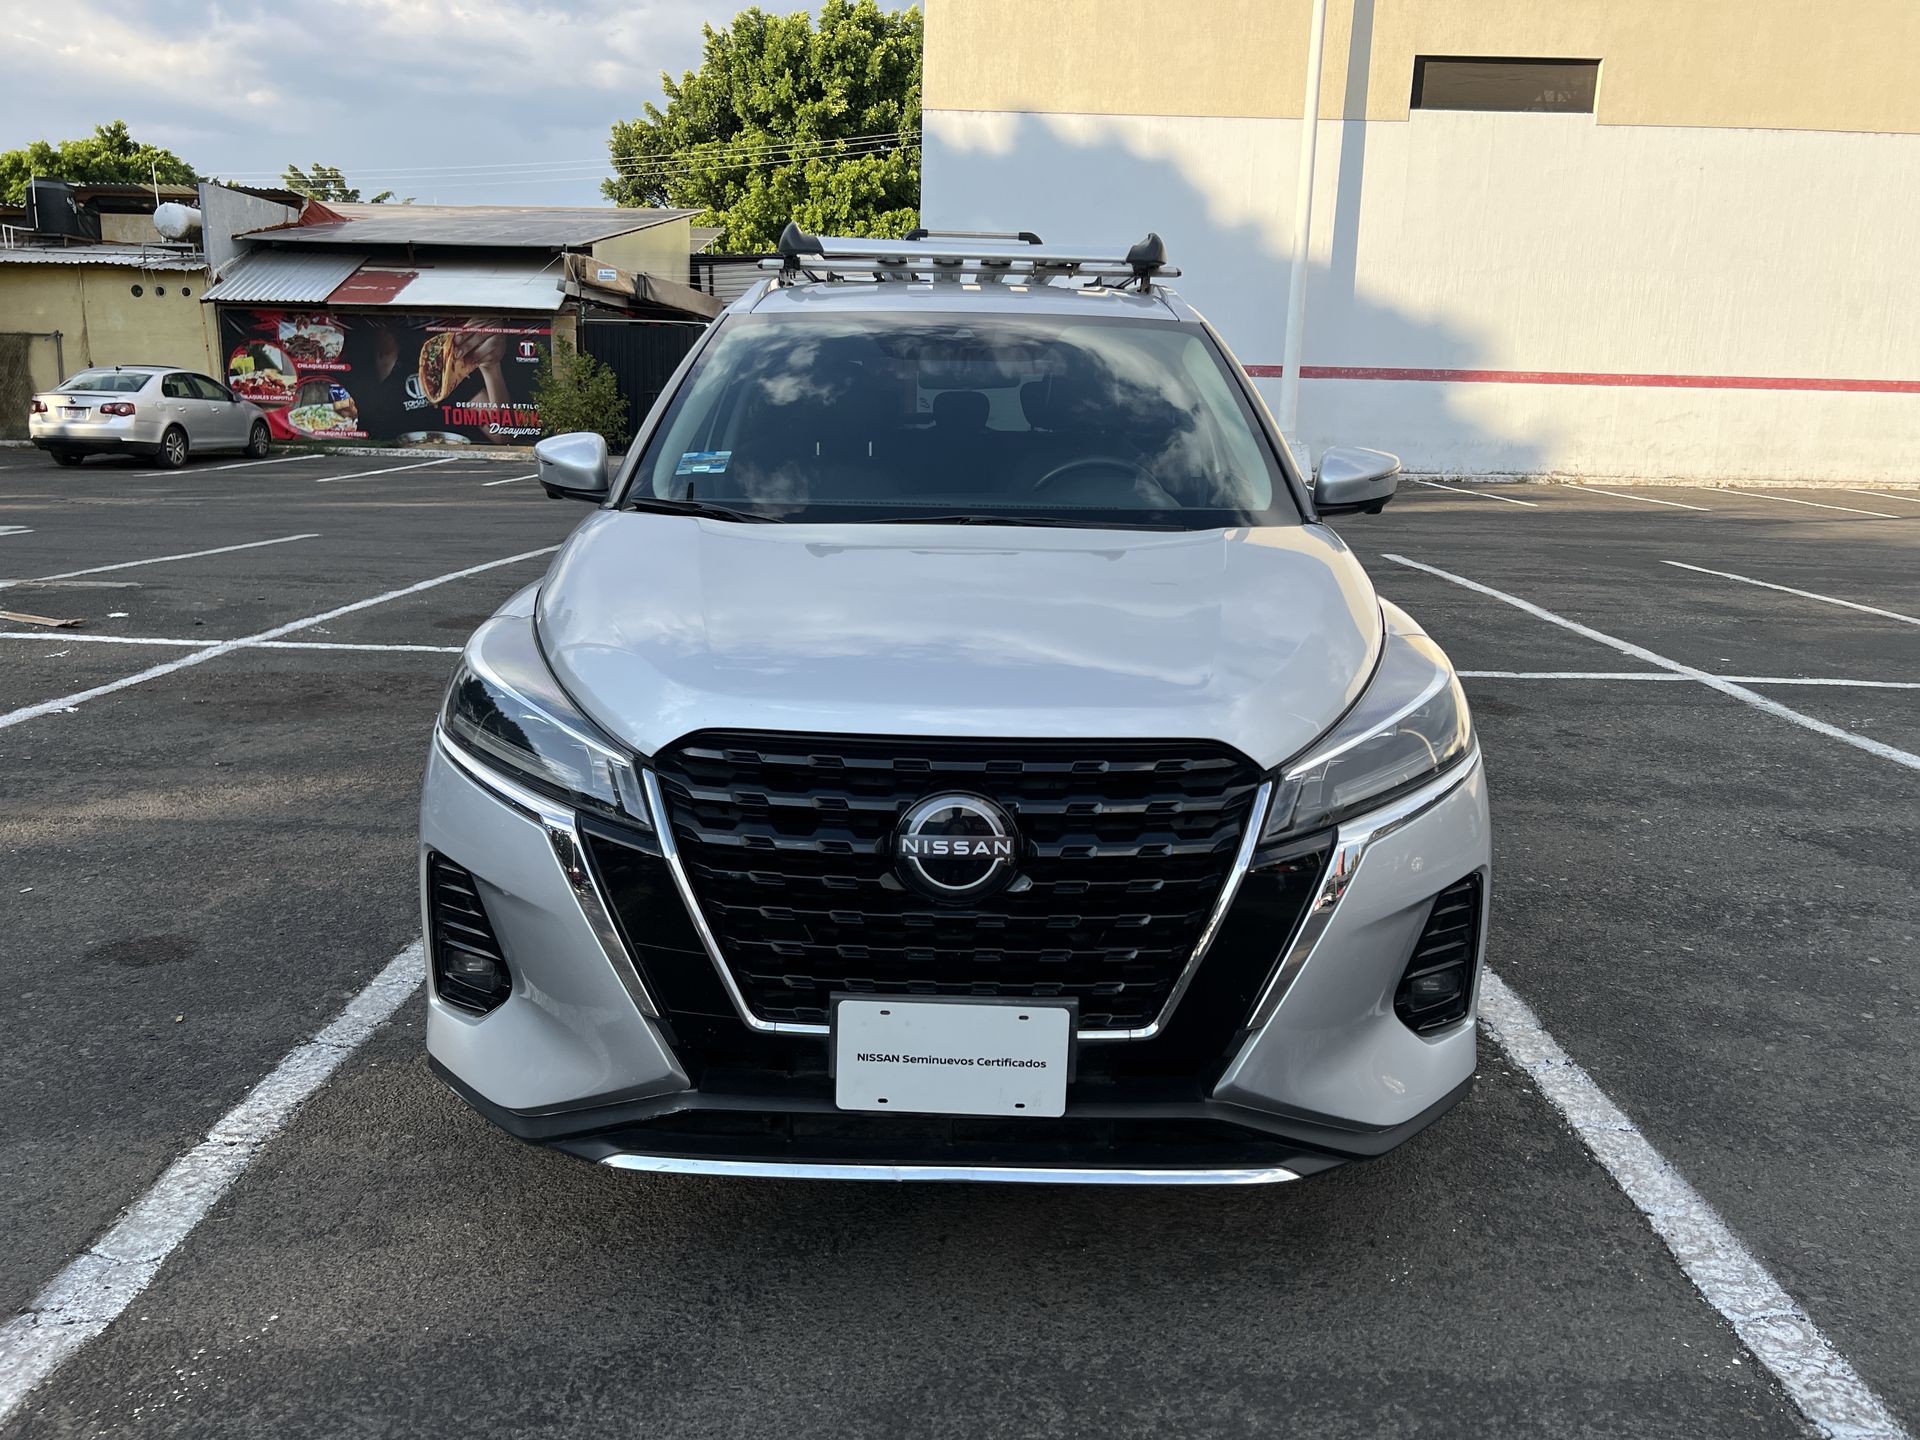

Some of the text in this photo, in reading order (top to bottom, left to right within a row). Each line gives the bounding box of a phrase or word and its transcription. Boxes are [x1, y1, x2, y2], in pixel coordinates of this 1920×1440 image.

[297, 362, 329, 370] CHILAQUILES
[456, 401, 498, 409] DESPIERTA
[489, 422, 541, 438] Desayunos
[902, 838, 1011, 855] NISSAN
[856, 1053, 1047, 1069] NISSAN Seminuevos Certificados
